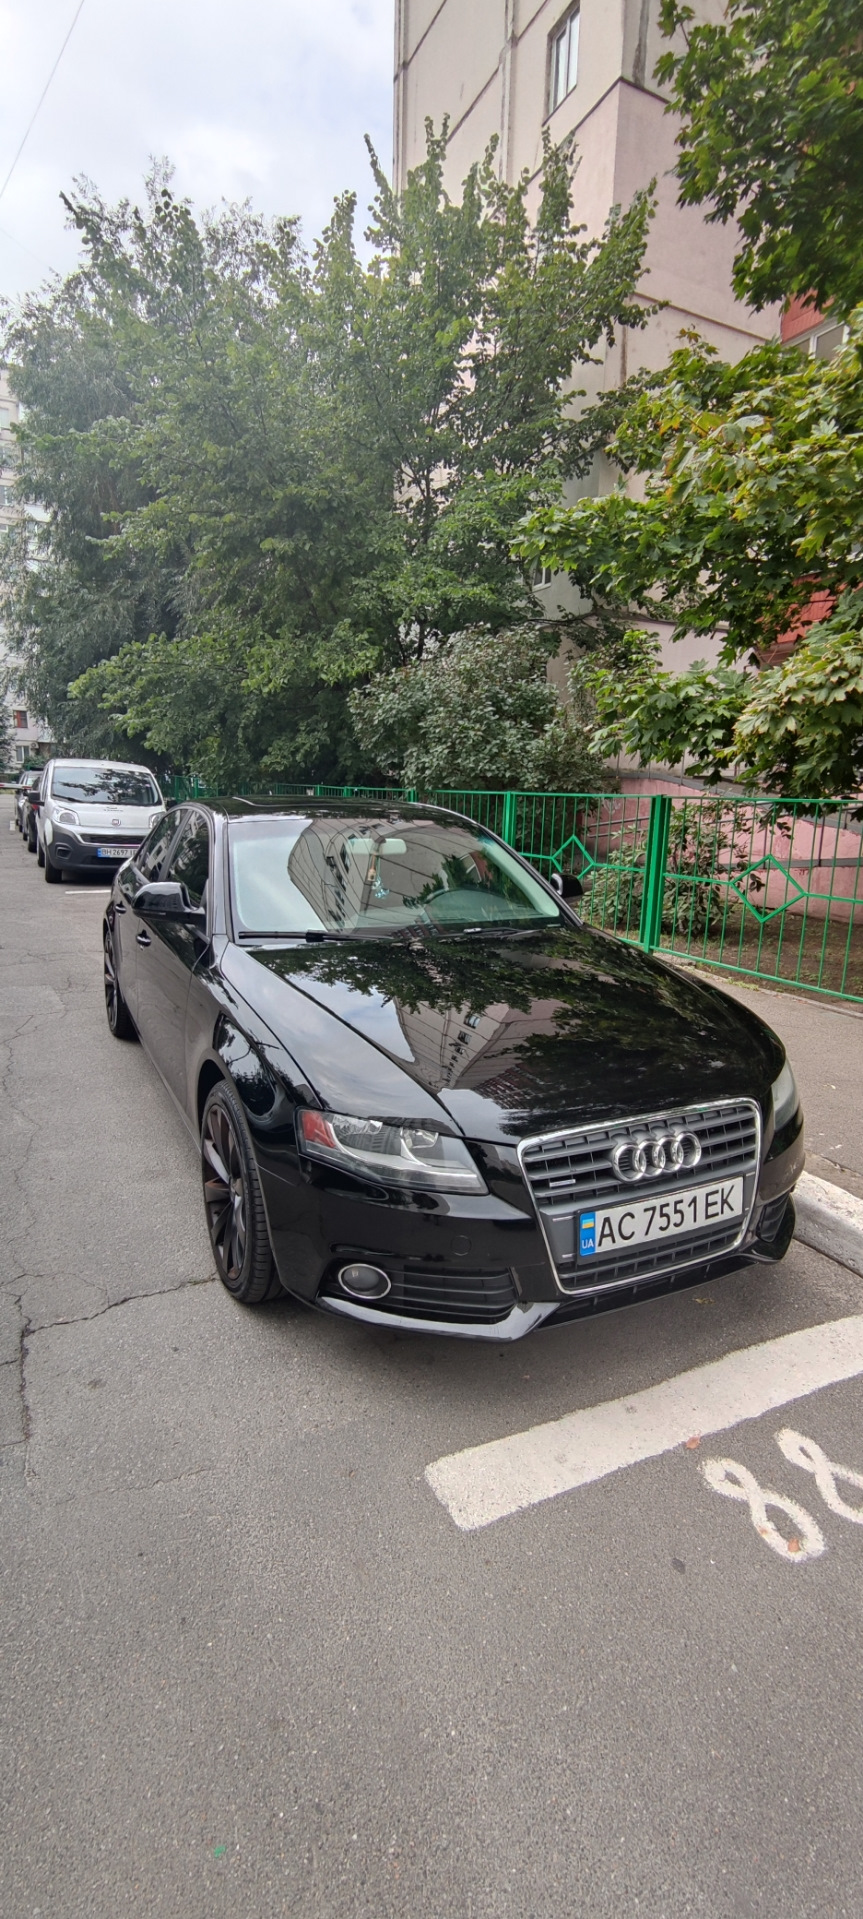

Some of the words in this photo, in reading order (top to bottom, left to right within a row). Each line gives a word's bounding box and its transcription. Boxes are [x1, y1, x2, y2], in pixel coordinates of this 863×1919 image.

[597, 1211, 635, 1247] AC
[644, 1195, 698, 1236] 7551
[705, 1185, 735, 1221] EK
[581, 1239, 595, 1250] UA
